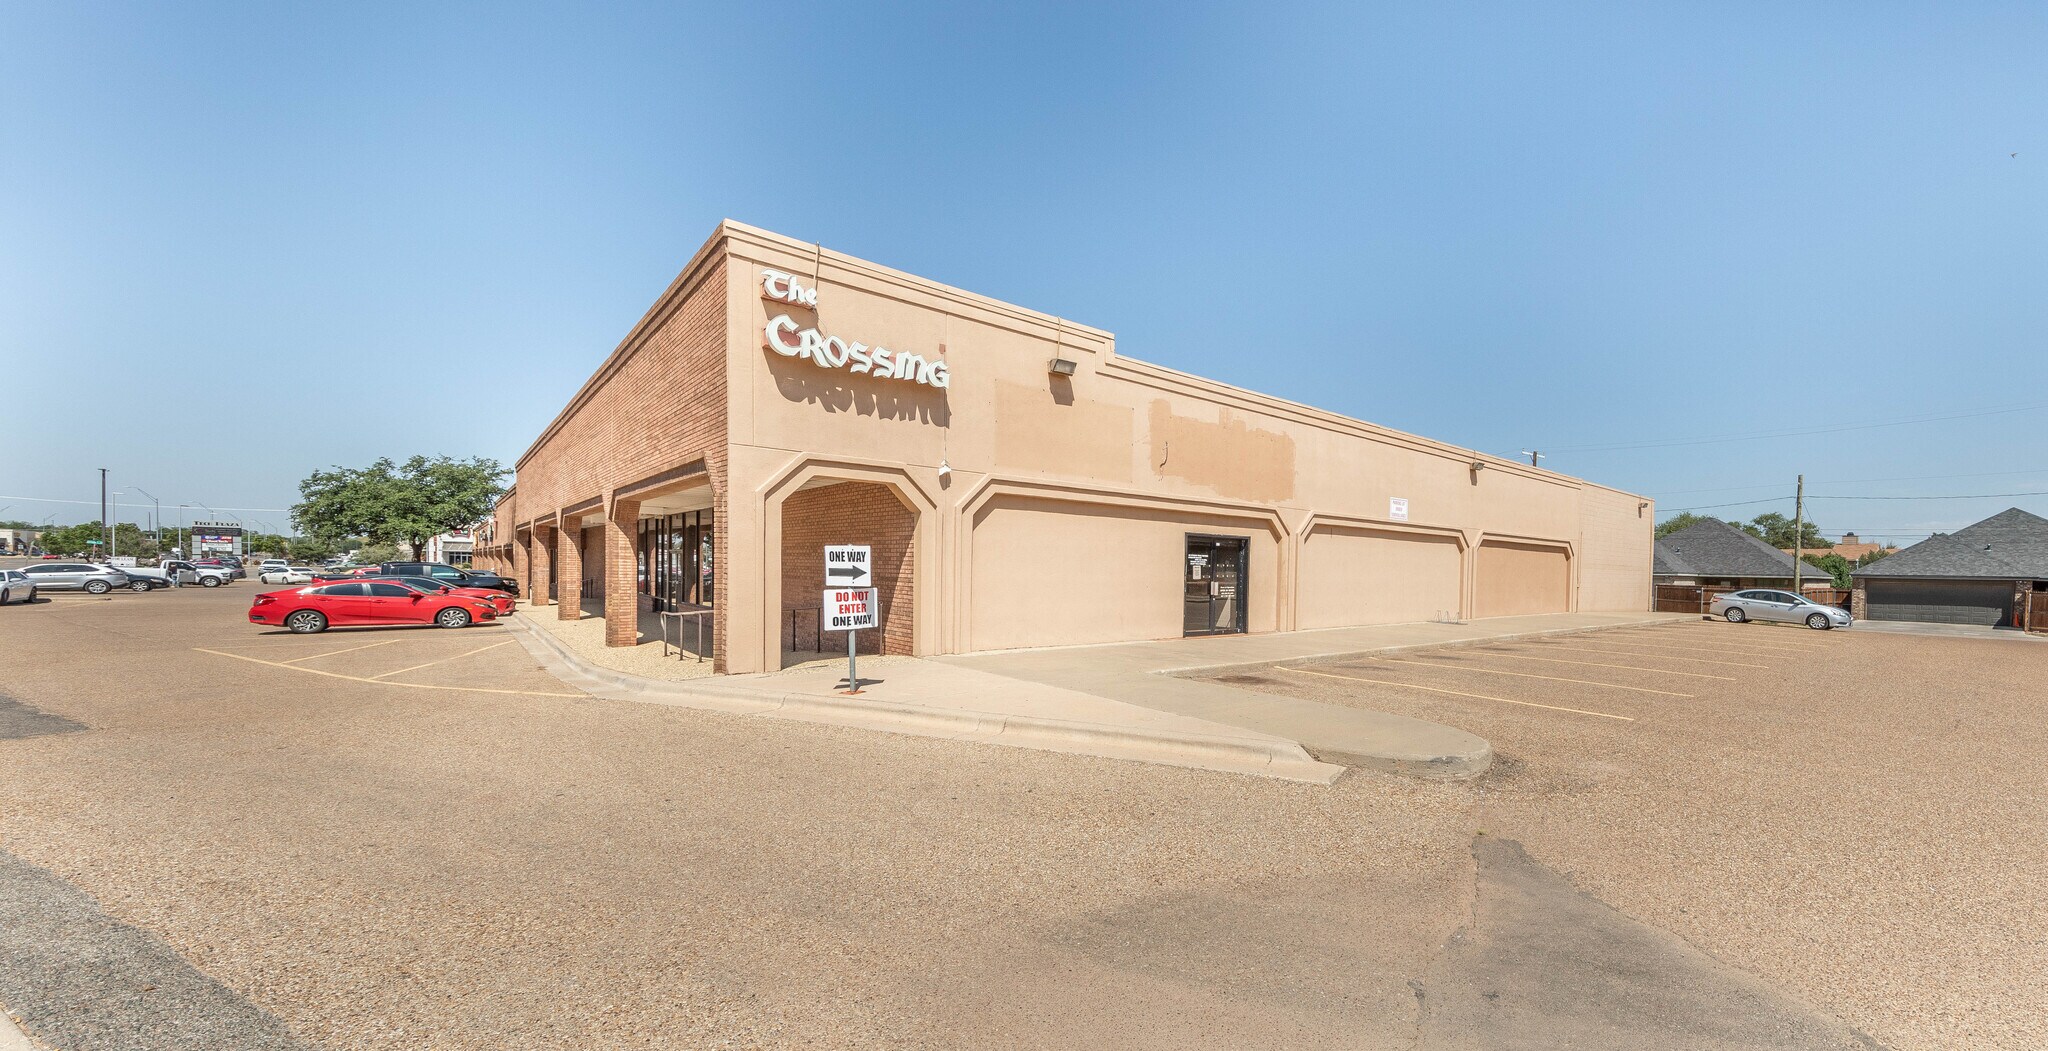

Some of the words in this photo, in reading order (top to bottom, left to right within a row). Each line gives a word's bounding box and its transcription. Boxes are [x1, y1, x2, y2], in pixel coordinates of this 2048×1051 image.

[761, 269, 818, 305] The
[829, 551, 846, 562] ONE
[847, 551, 867, 562] WAY
[835, 592, 849, 603] DO
[851, 591, 869, 601] NOT
[838, 603, 867, 614] ENTER
[832, 616, 851, 627] ONE
[853, 614, 872, 625] WAY
